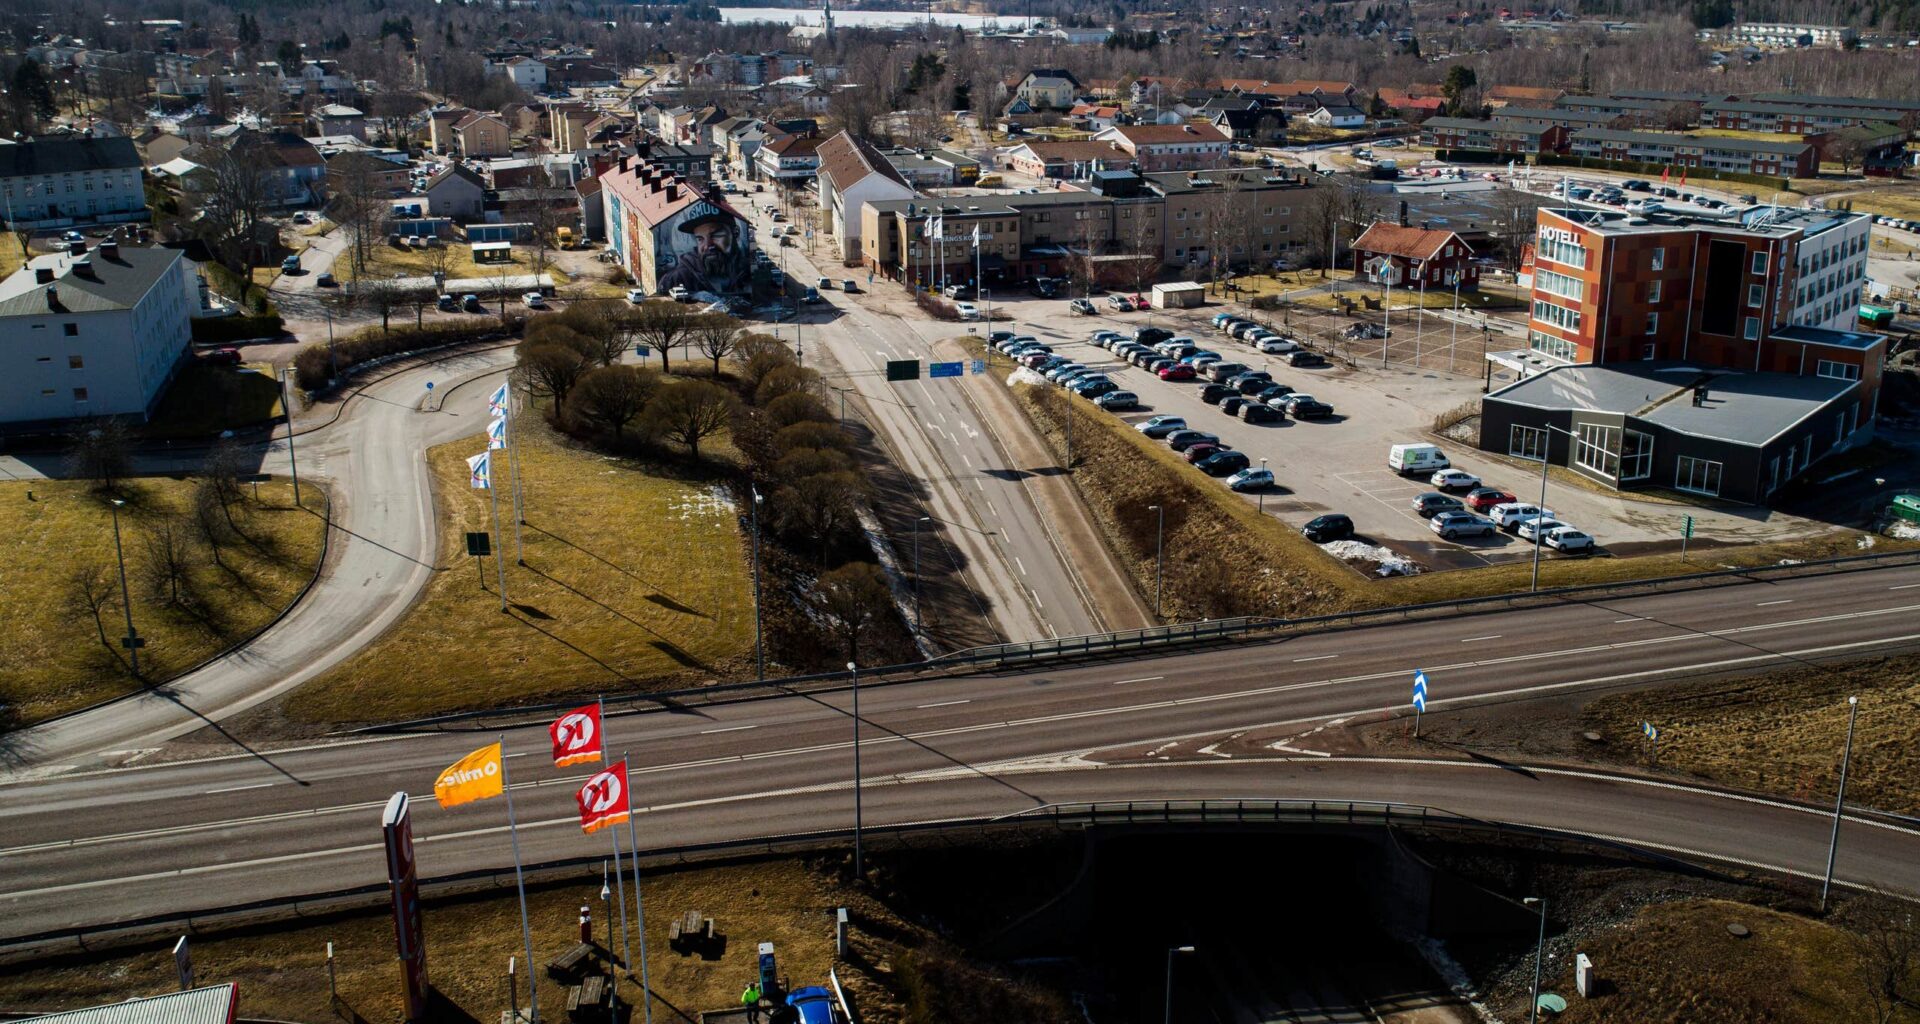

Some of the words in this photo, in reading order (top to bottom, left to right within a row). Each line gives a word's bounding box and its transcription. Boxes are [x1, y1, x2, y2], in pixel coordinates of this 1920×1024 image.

[691, 202, 720, 219] SMUG
[963, 233, 994, 241] KOMUN
[1539, 224, 1581, 247] HOTELL
